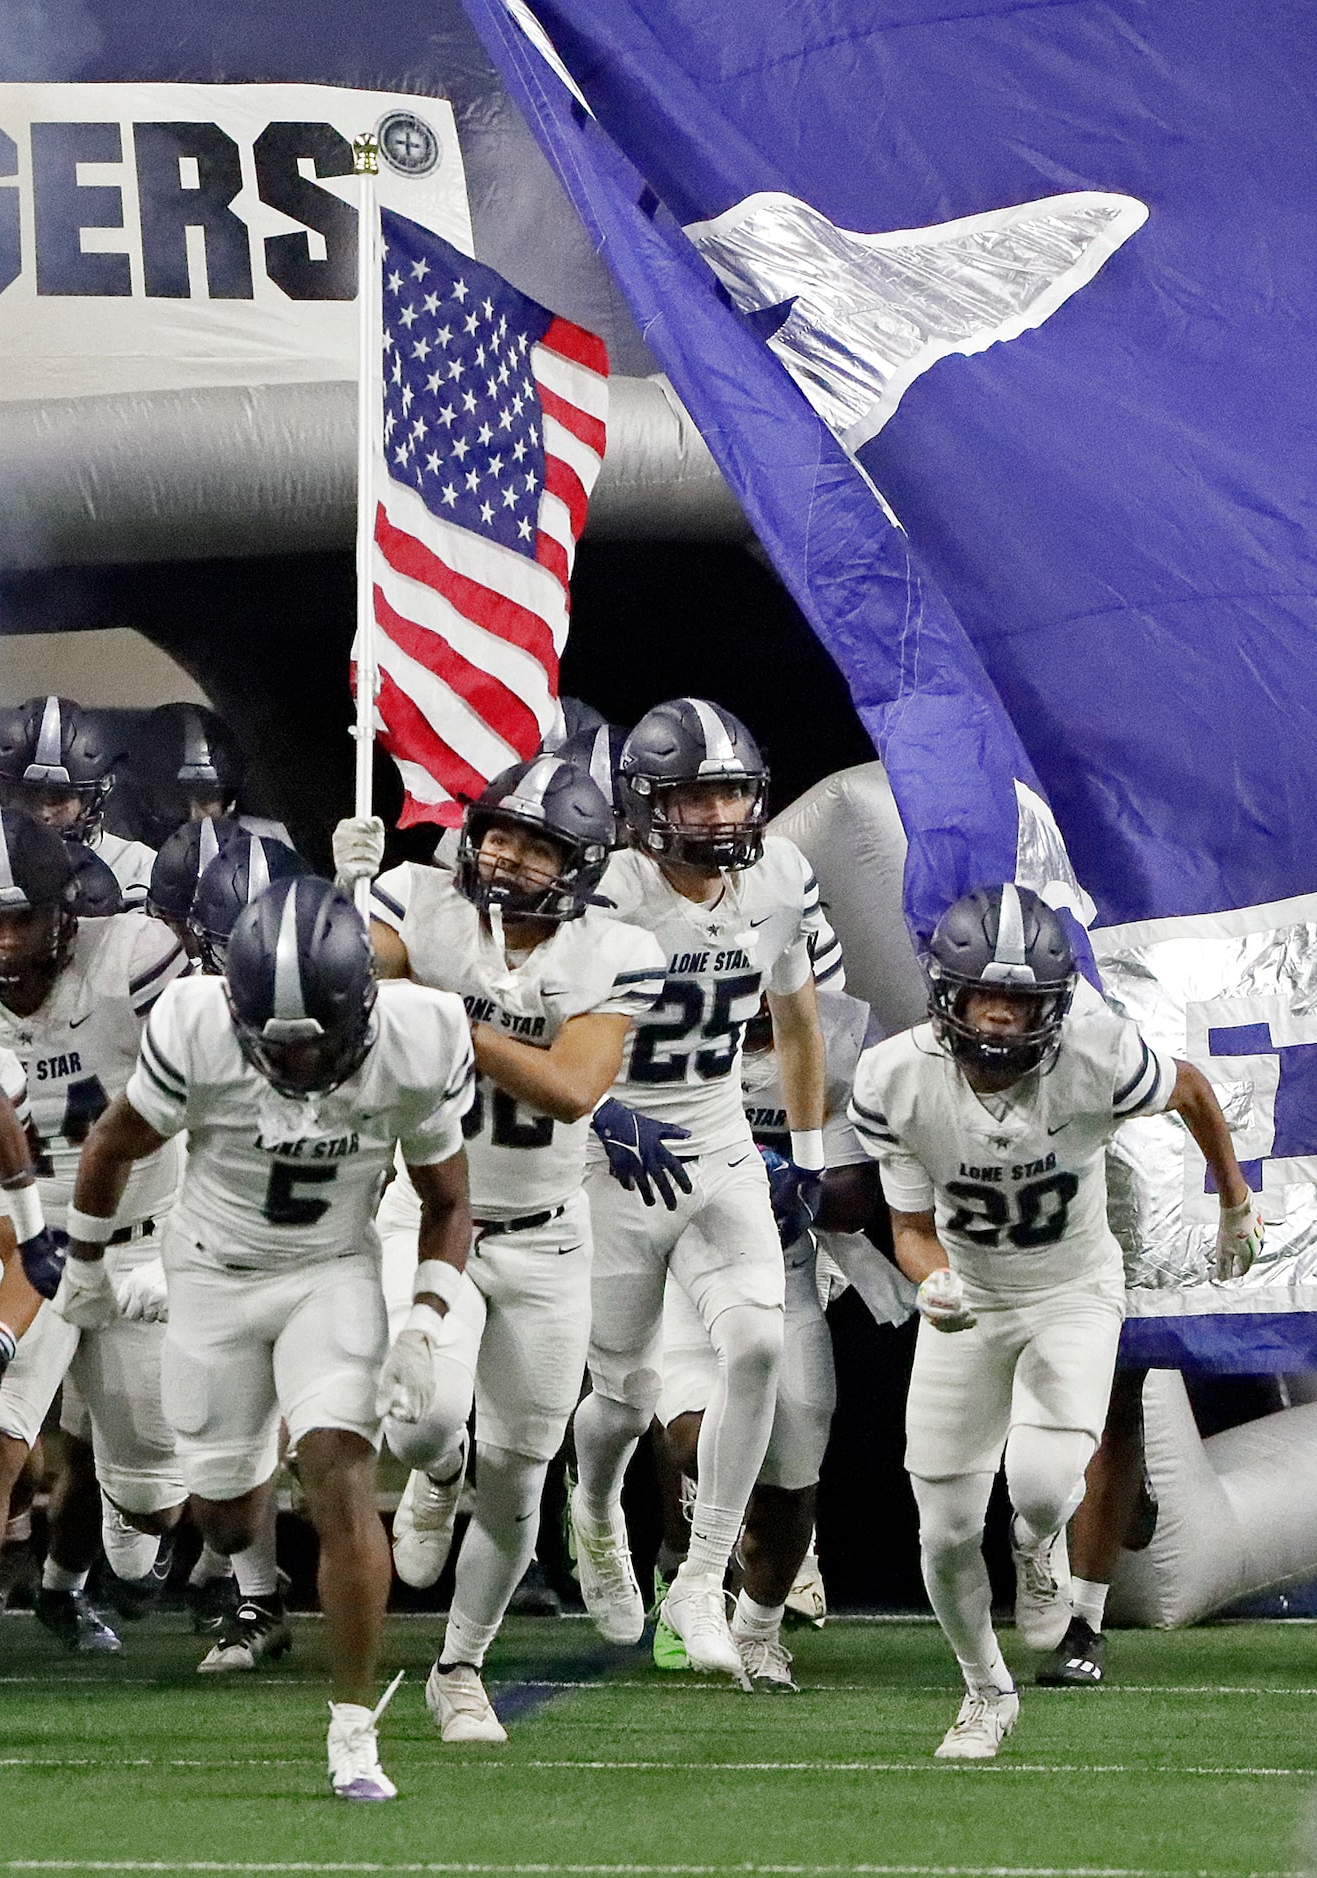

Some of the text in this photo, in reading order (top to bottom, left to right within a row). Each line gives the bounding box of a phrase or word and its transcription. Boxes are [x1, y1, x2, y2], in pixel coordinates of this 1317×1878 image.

[668, 951, 710, 974] LONE
[500, 1012, 546, 1037] STAR
[627, 971, 762, 1083] 25
[36, 1051, 82, 1081] STAR
[311, 1132, 359, 1159] STAR
[959, 1152, 1057, 1181] LONE STAR
[945, 1171, 1079, 1248] 20
